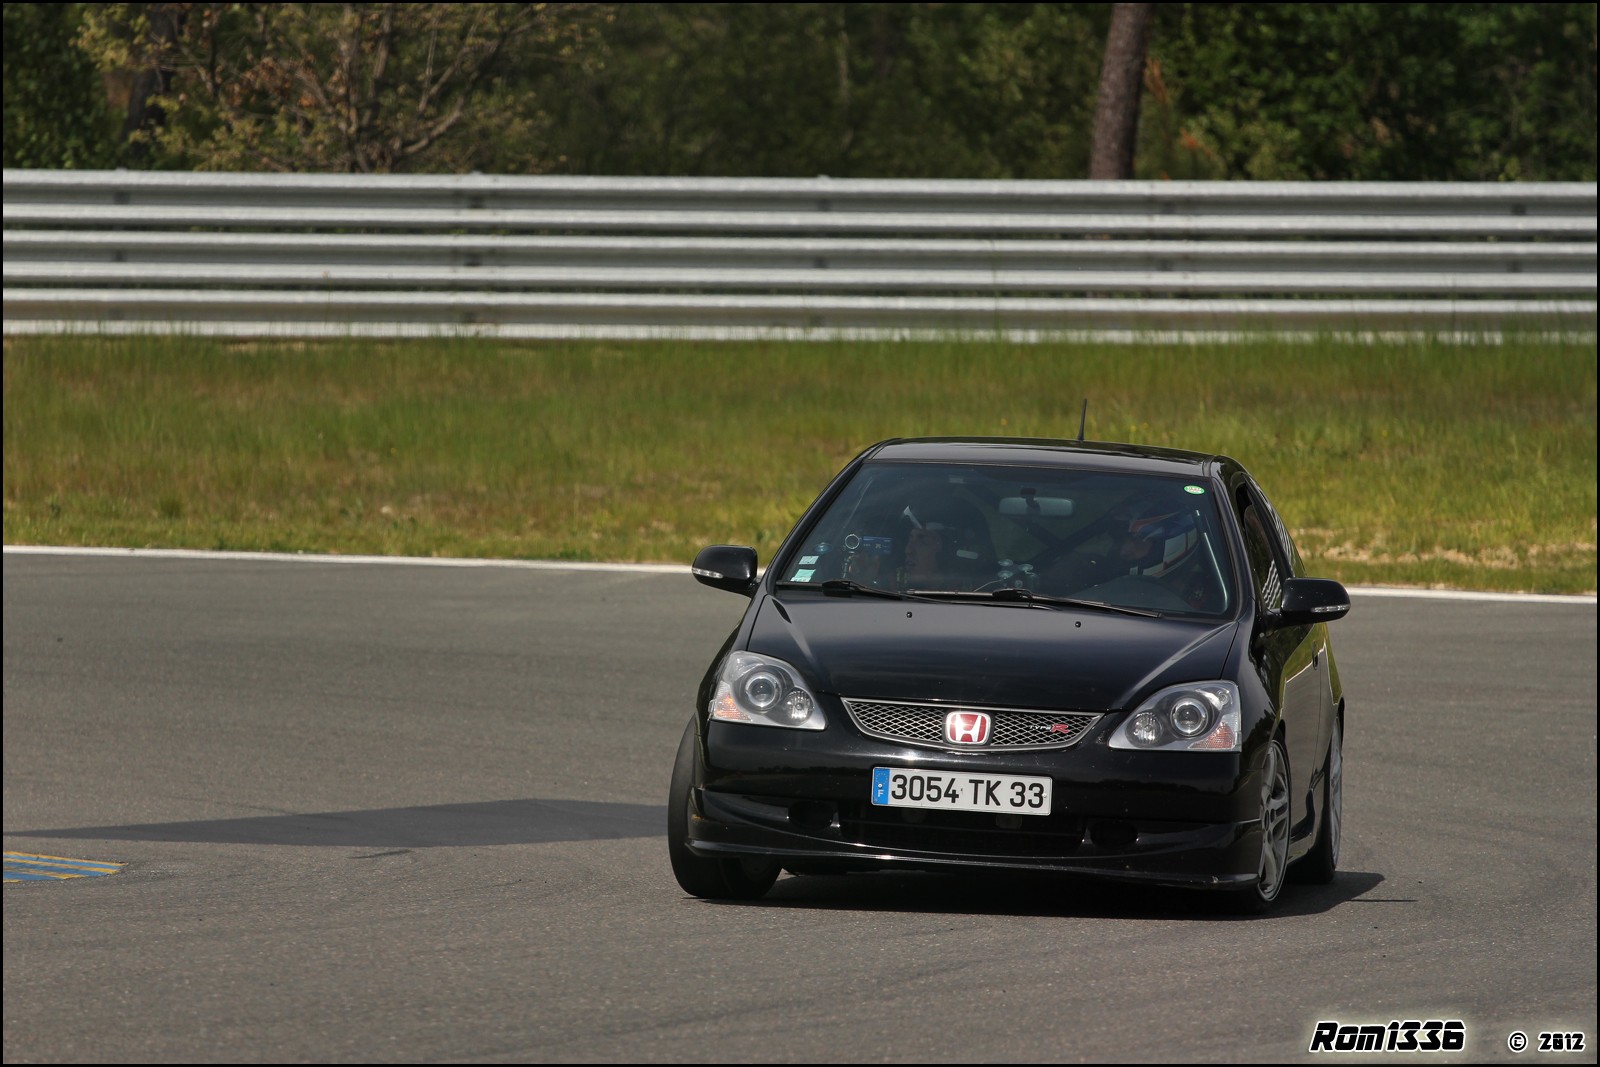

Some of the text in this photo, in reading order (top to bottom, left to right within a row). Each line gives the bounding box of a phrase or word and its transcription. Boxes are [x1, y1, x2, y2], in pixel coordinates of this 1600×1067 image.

[877, 790, 885, 798] F
[891, 774, 1045, 808] 3054 TK 33
